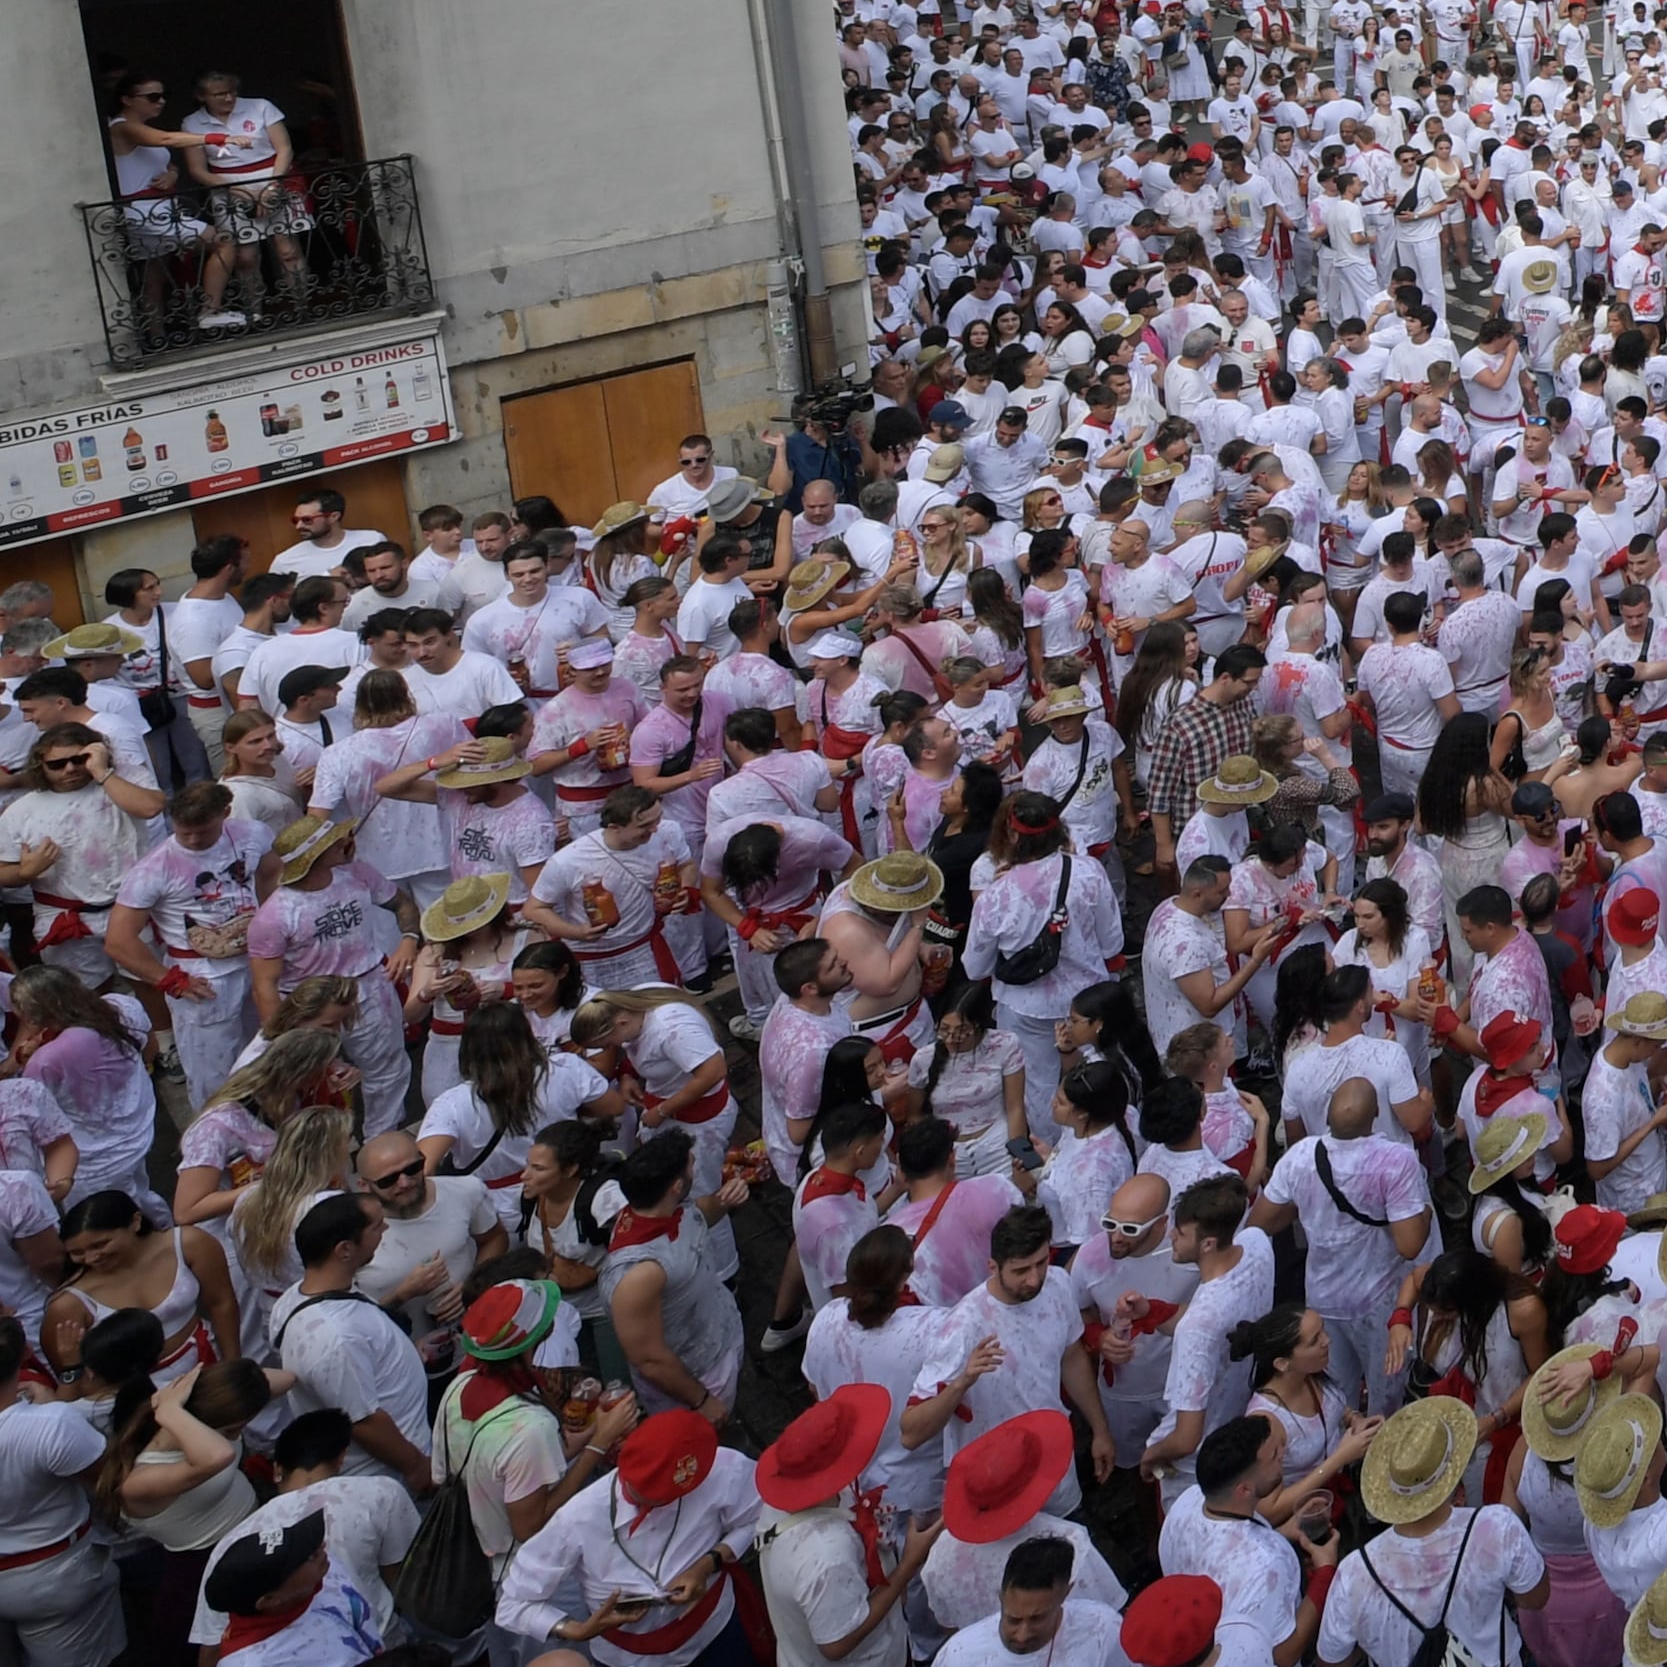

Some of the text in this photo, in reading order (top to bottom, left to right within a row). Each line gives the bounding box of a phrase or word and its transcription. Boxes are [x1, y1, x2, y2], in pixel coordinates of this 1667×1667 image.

[290, 343, 425, 381] COLD DRINKS
[77, 402, 144, 427] FRÍAS
[315, 900, 362, 928] STOKE
[312, 916, 363, 945] TRAVE
